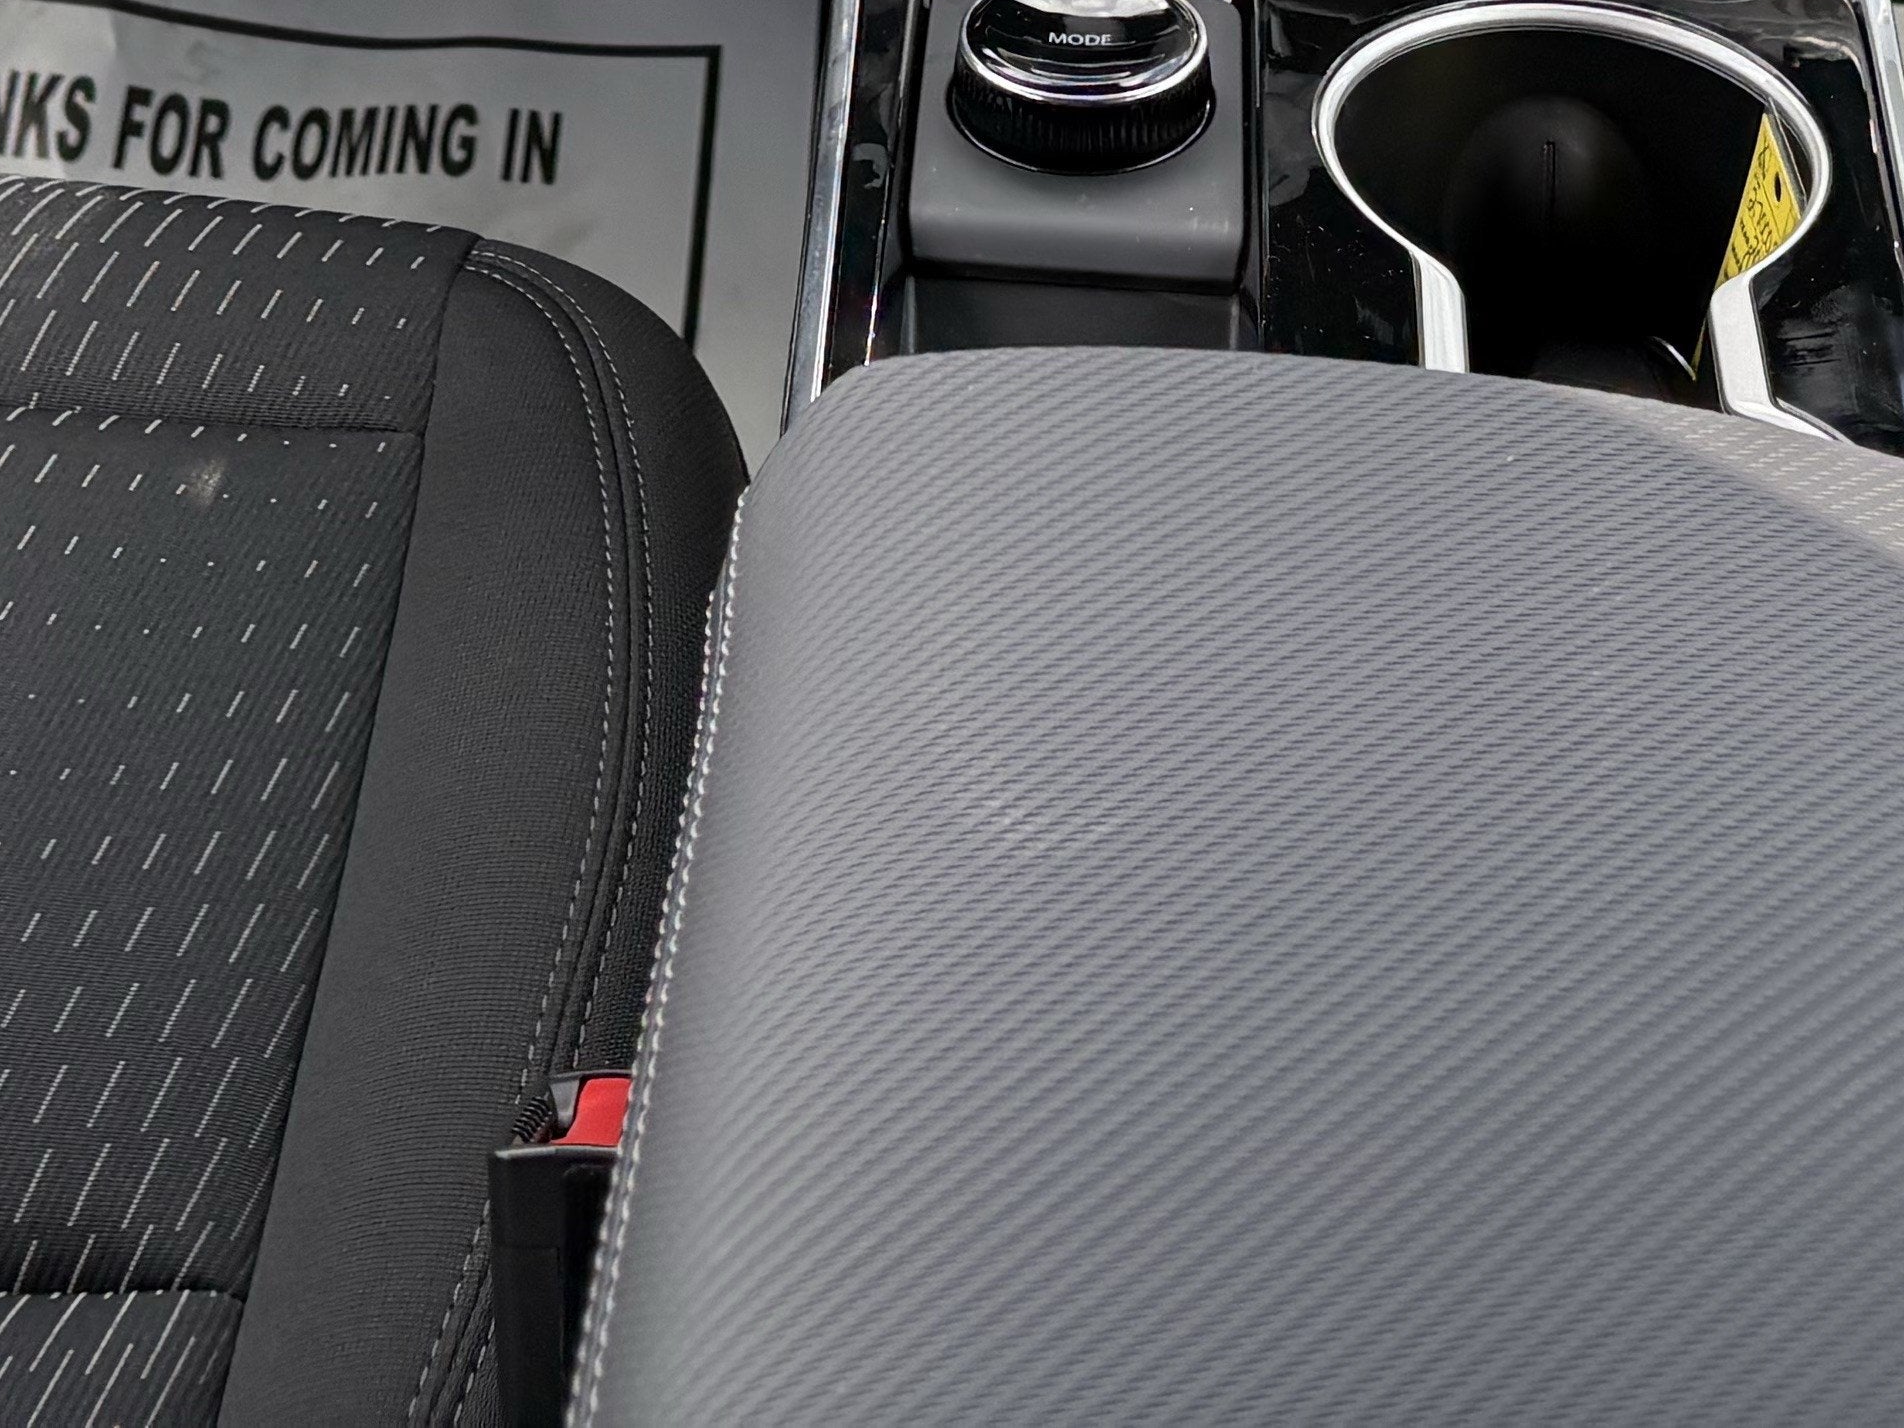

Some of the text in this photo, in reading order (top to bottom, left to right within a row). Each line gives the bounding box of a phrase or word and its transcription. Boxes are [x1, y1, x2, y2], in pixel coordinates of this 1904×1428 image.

[1048, 32, 1112, 46] MODE
[114, 85, 230, 180] FOR
[252, 104, 478, 182] COMING
[498, 107, 563, 185] IN
